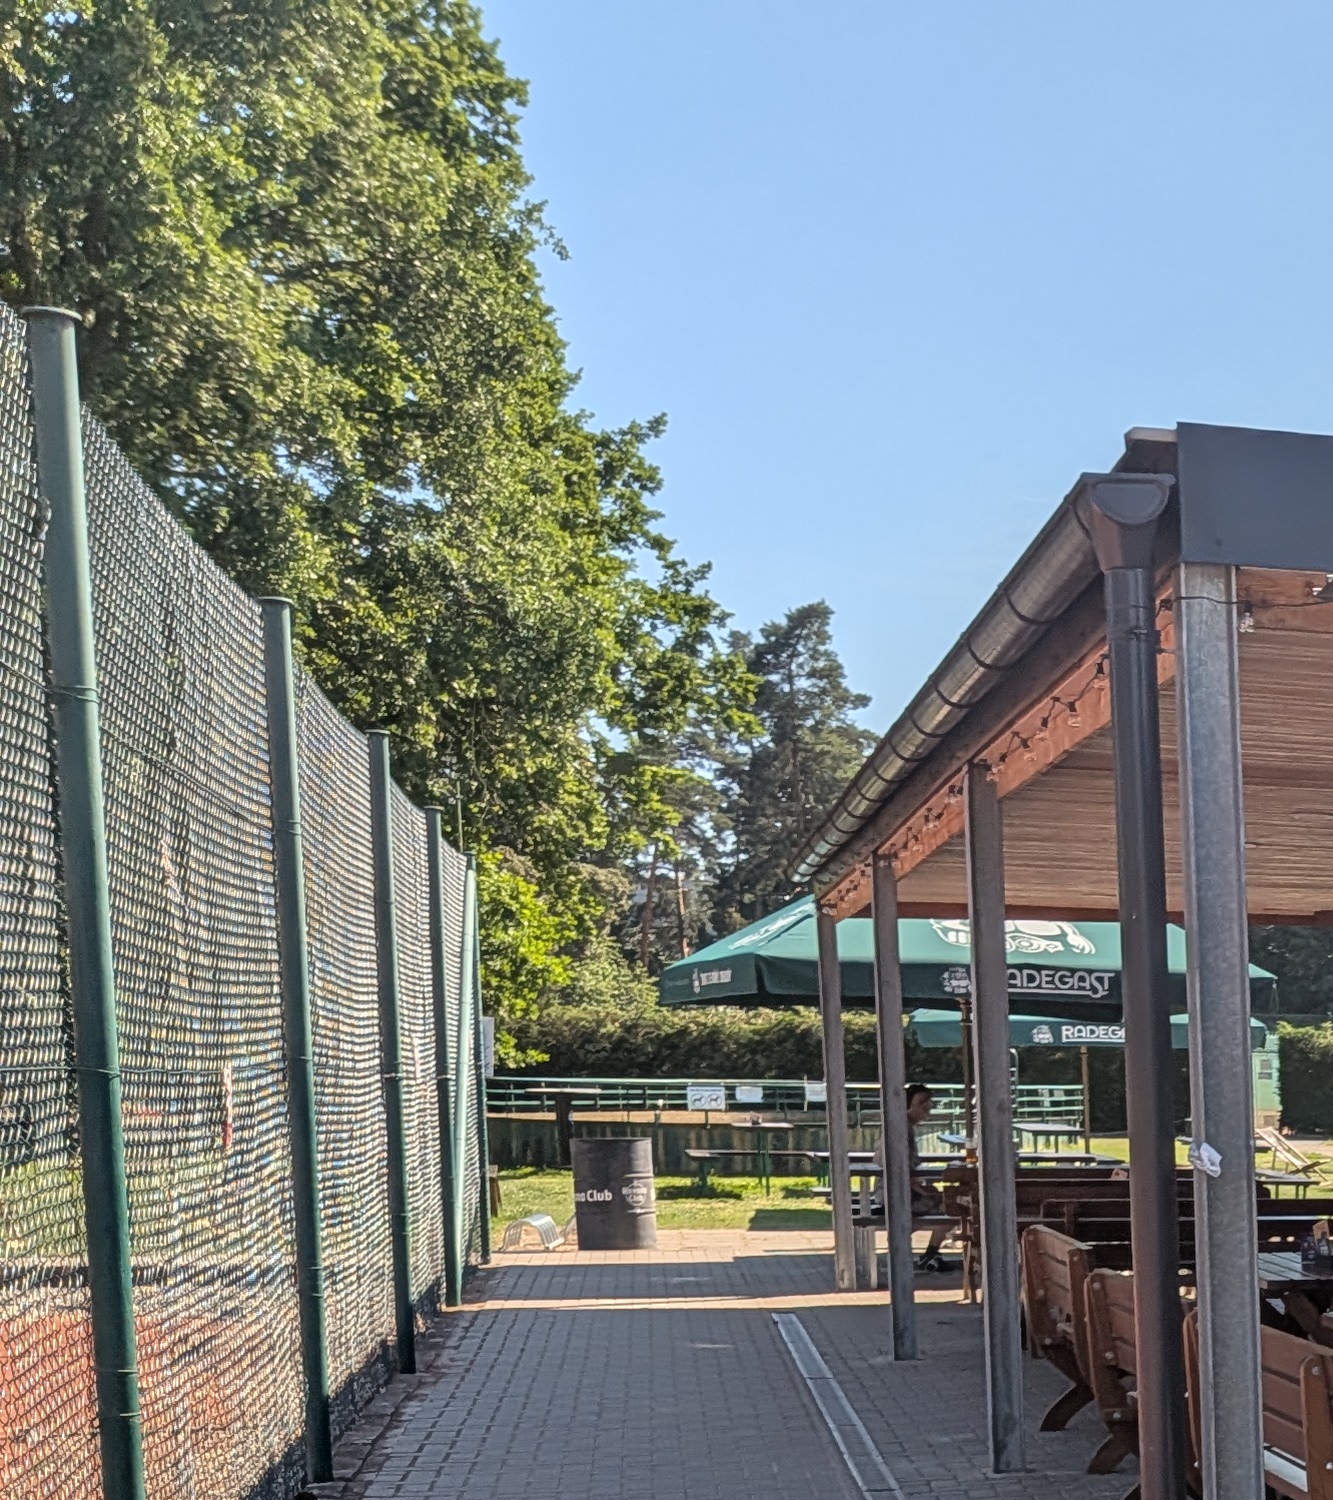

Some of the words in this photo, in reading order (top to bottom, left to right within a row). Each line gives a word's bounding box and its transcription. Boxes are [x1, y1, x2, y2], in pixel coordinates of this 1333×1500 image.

[1007, 969, 1115, 998] ADEGAST
[1061, 1025, 1125, 1042] RADEG
[586, 1188, 613, 1202] Club
